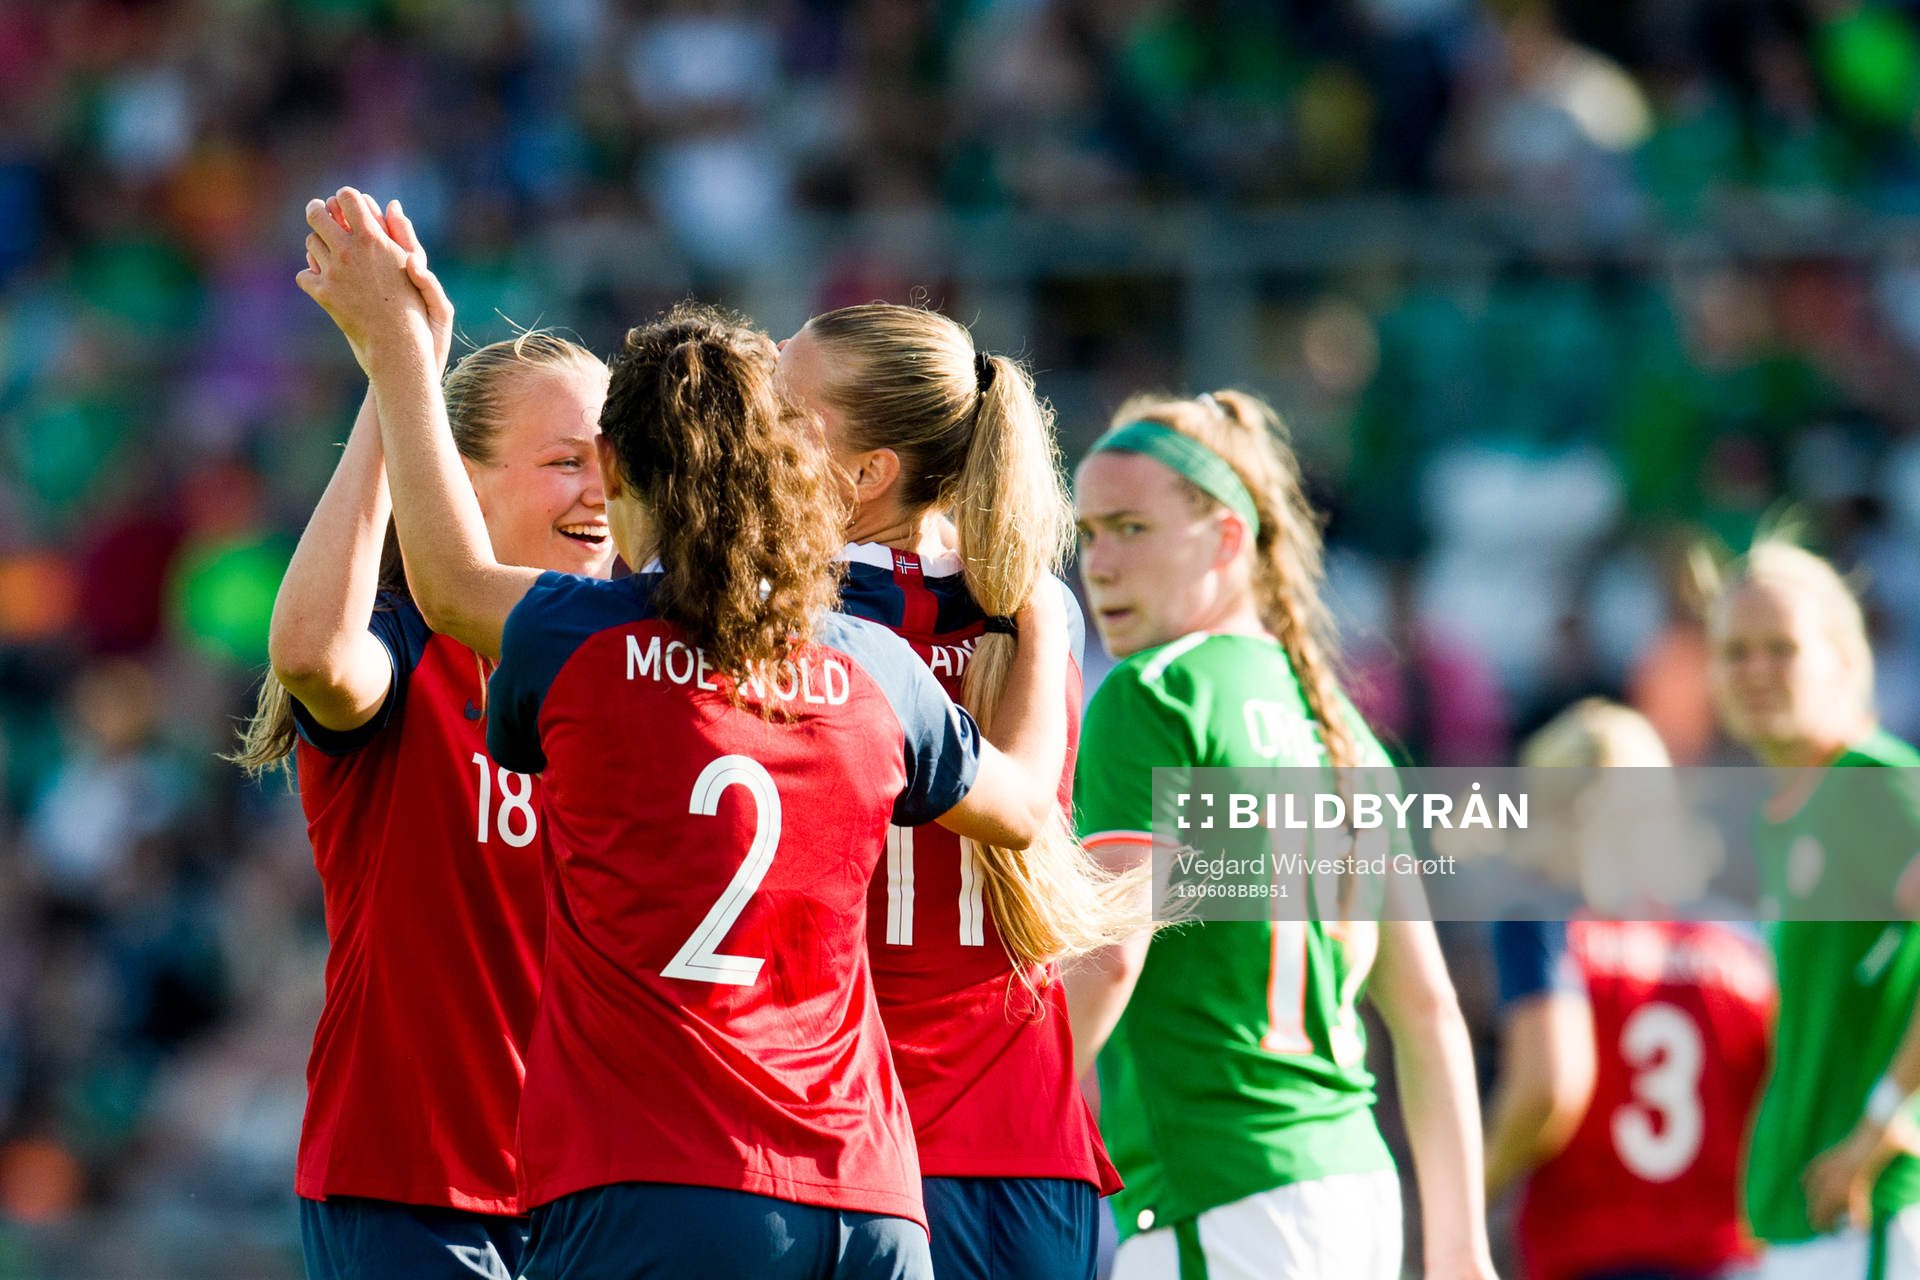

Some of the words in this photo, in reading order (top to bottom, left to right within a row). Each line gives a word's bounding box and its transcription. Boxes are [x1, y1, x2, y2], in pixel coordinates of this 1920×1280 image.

[625, 634, 718, 692] MOE
[471, 751, 538, 848] 18
[659, 754, 782, 987] 2
[1612, 1004, 1704, 1182] 3
